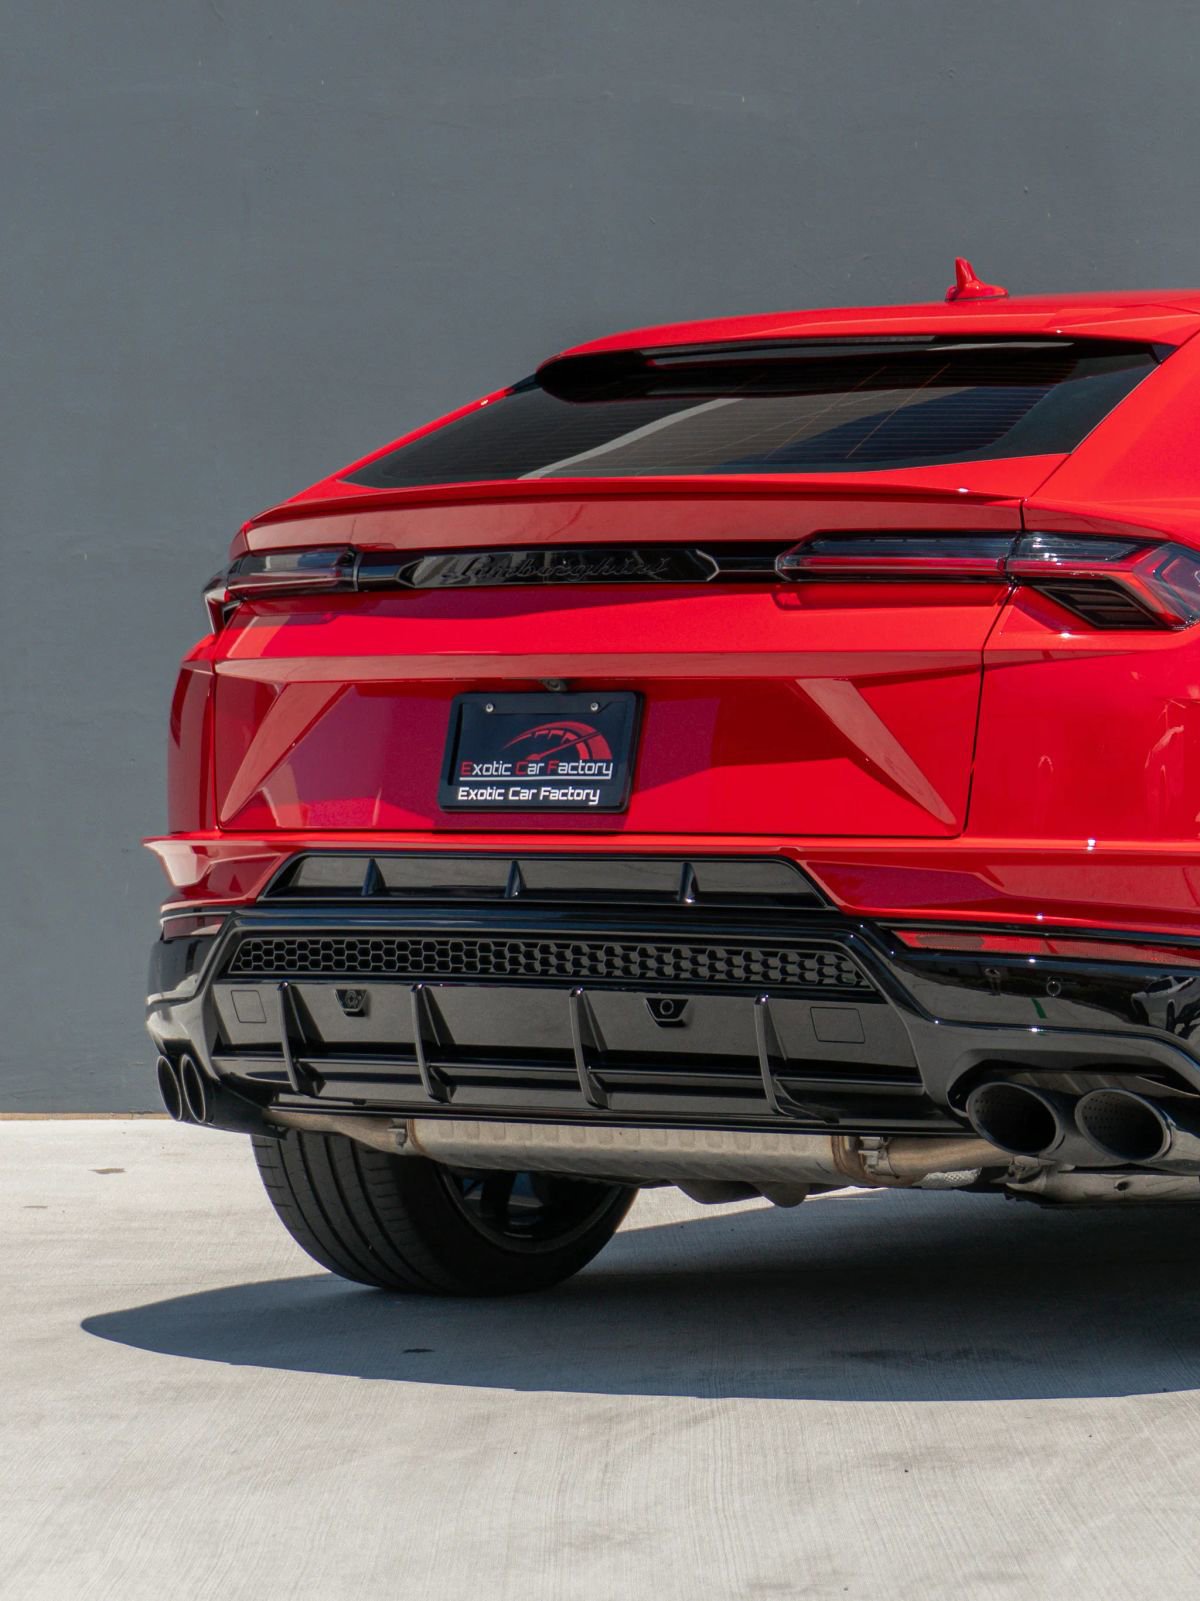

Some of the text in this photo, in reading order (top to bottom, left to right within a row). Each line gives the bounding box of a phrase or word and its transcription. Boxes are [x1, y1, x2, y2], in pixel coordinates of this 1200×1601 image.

[461, 759, 613, 779] Exotic Car Factory
[458, 786, 601, 805] Exotic Car Factory
